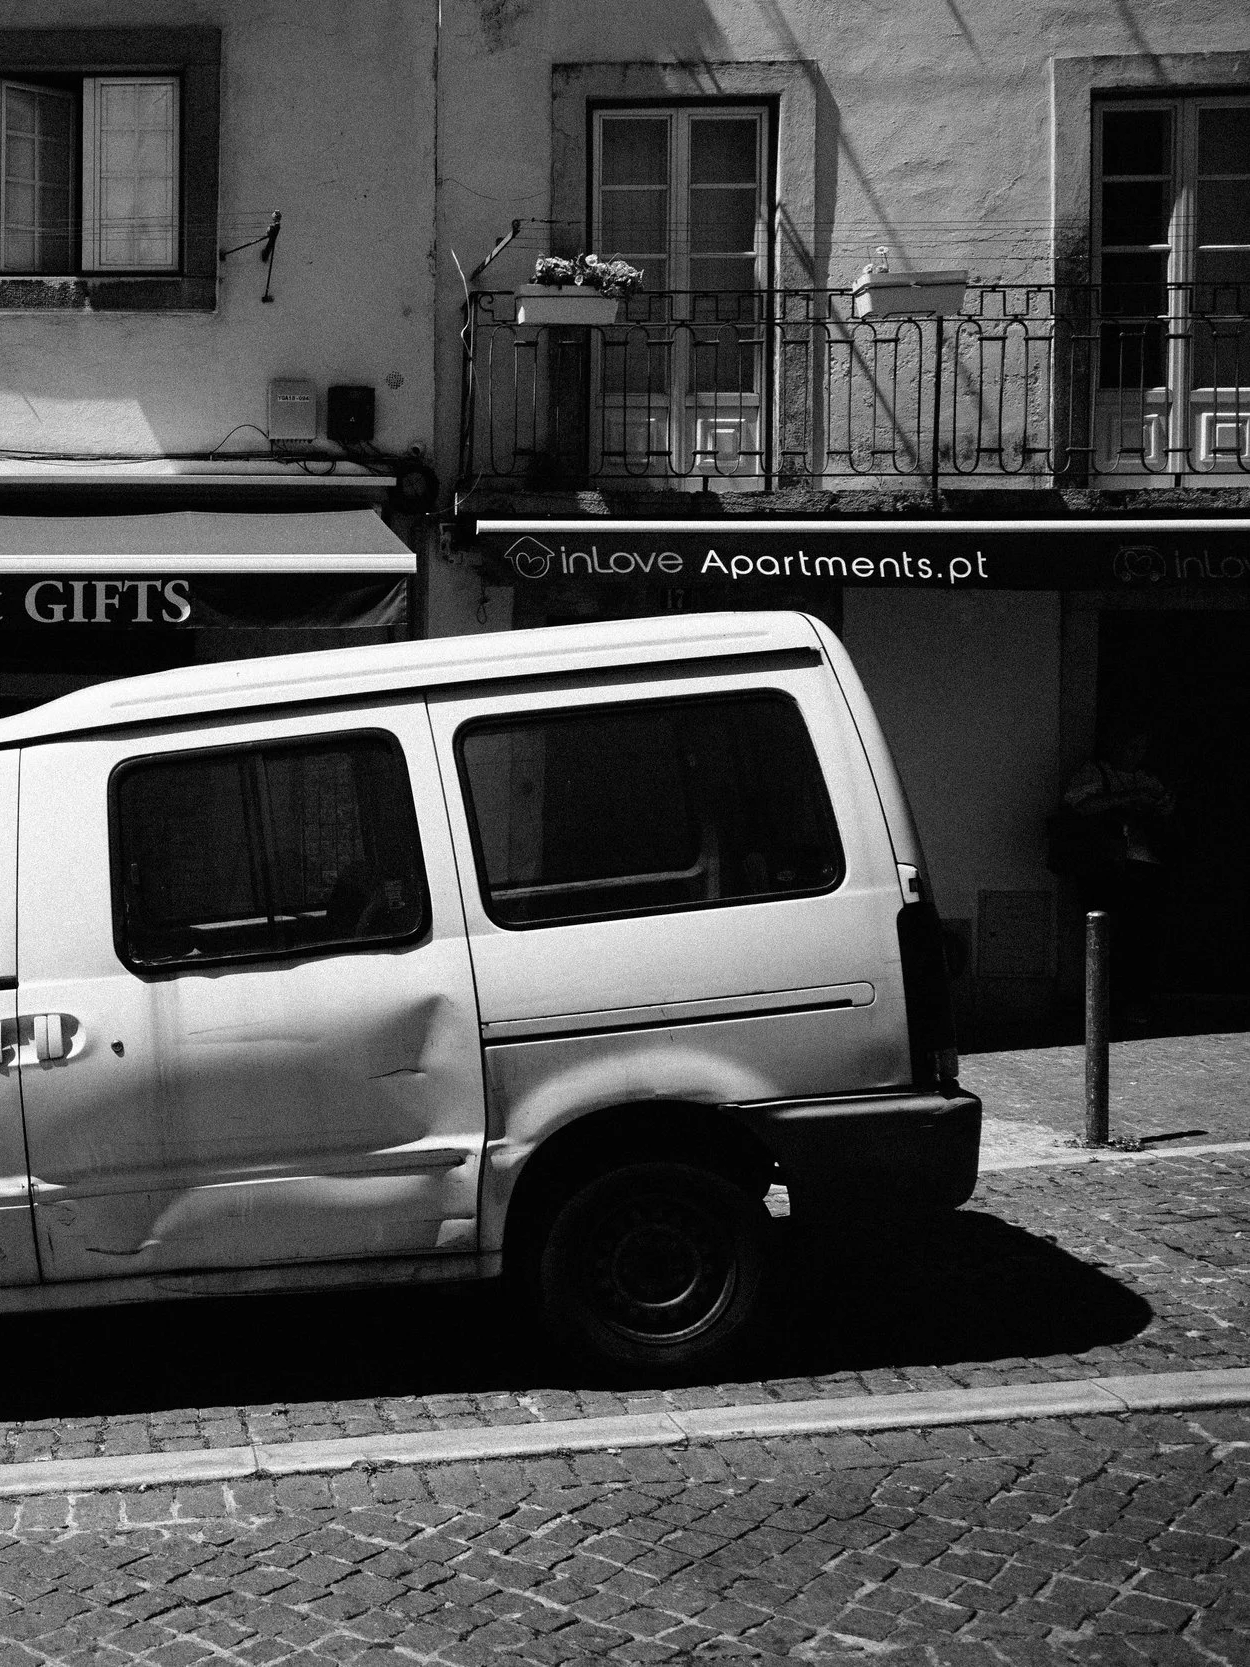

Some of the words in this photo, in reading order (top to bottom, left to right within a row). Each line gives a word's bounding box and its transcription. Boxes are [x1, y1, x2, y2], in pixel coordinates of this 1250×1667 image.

[560, 545, 684, 575] inLove
[700, 549, 989, 585] Apartments.pt
[25, 580, 192, 623] GIFTS
